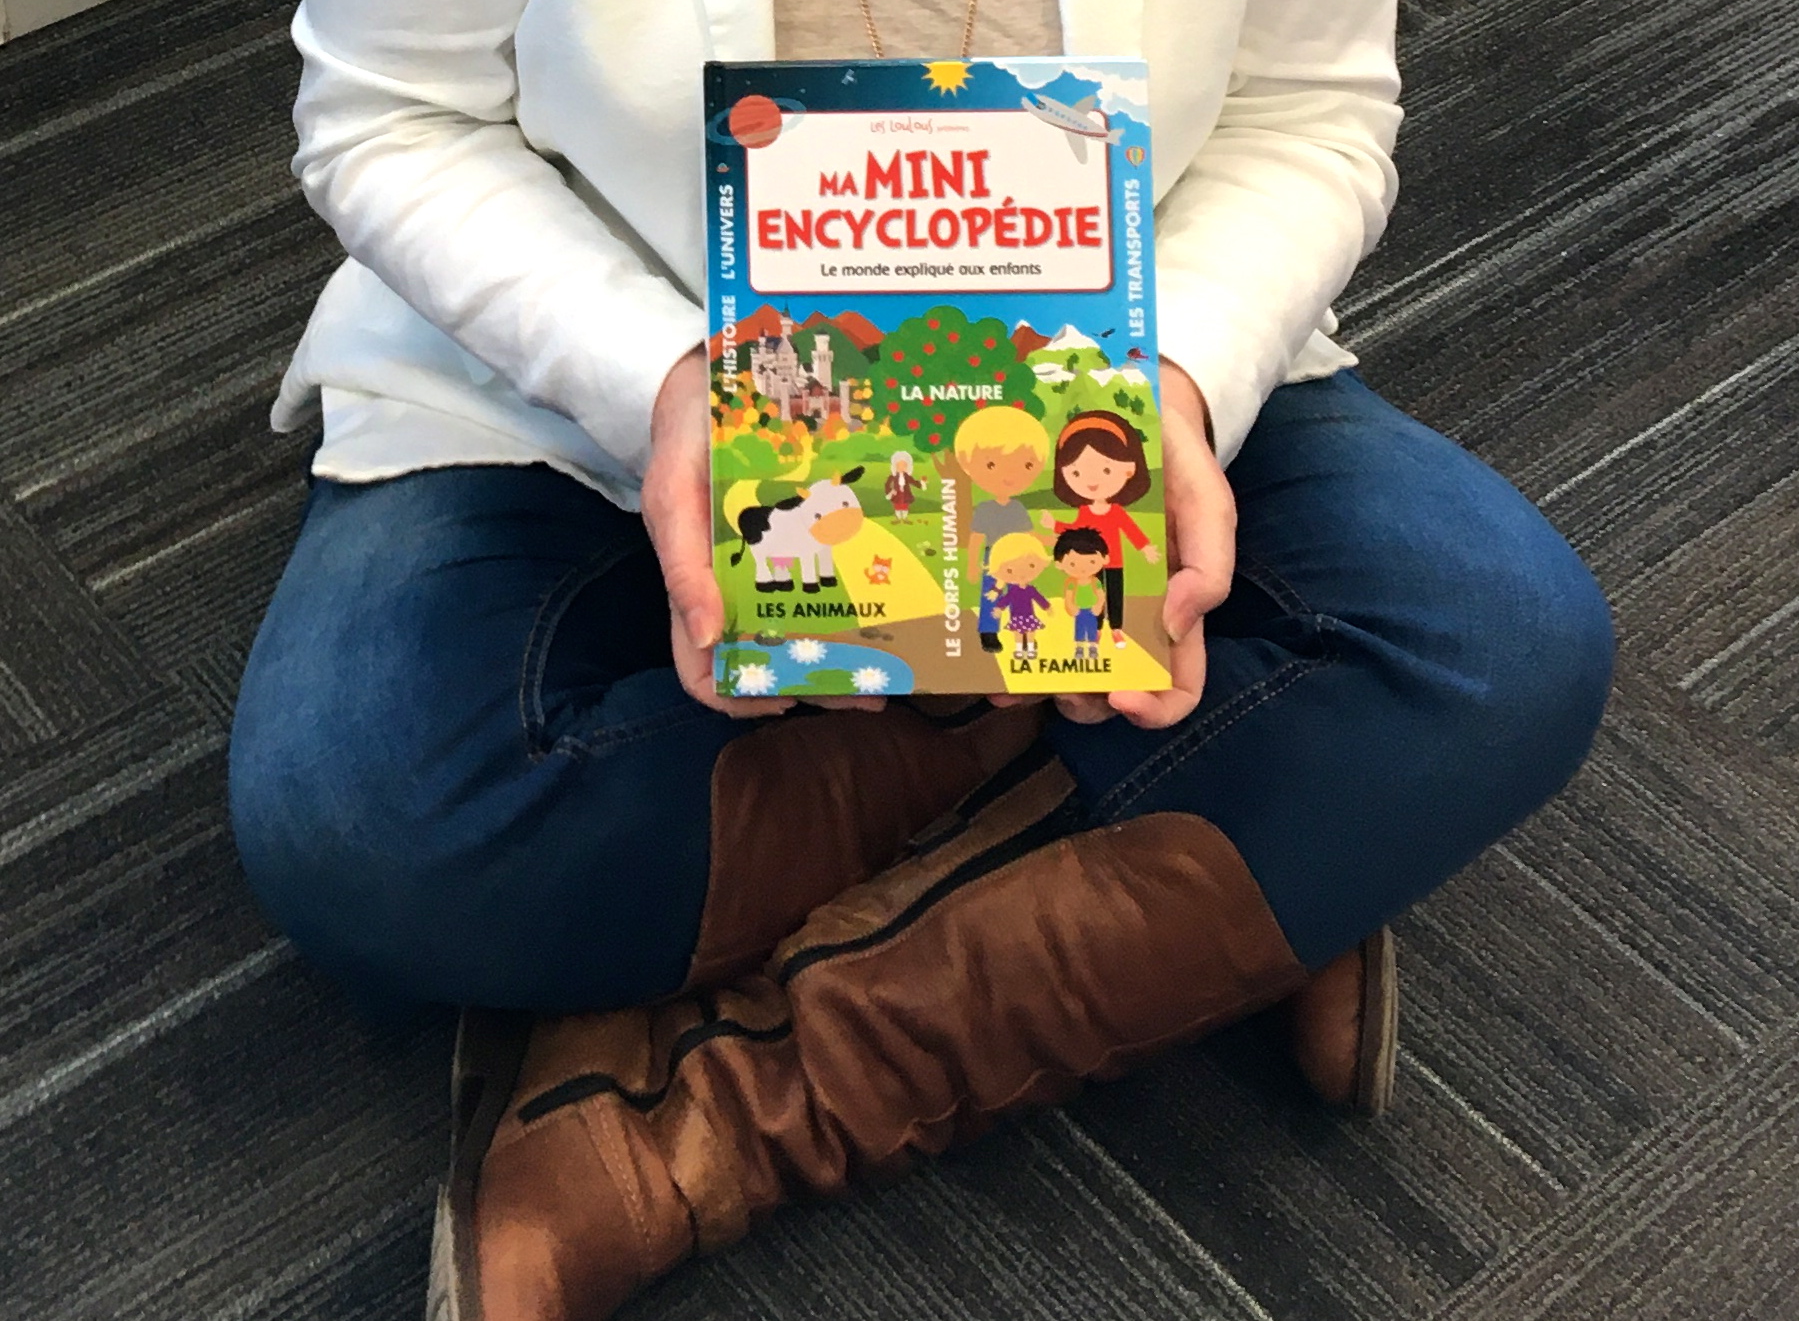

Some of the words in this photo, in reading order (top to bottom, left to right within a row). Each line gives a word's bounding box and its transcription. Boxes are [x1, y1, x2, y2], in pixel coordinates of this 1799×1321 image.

[819, 171, 859, 196] MA
[864, 149, 992, 200] MINI
[719, 184, 736, 279] L'UNIVERS
[757, 195, 1103, 250] ENCYCLOPÉDIE
[1124, 178, 1143, 302] TRANSPORTS
[820, 264, 838, 276] Le
[842, 263, 890, 276] monde
[894, 263, 955, 278] expliqué
[959, 265, 985, 276] aux
[989, 262, 1042, 276] enfants
[721, 295, 738, 393] L'HISTOIRE
[1129, 307, 1146, 338] LES
[900, 385, 924, 401] LA
[929, 384, 1003, 401] NATURE
[941, 479, 959, 561] HUMAIN
[756, 602, 786, 618] LES
[792, 602, 887, 618] ANIMAUX
[943, 567, 961, 633] CORPS
[945, 638, 962, 657] LE
[1010, 658, 1033, 674] LA
[1039, 658, 1112, 673] FAMILLE
